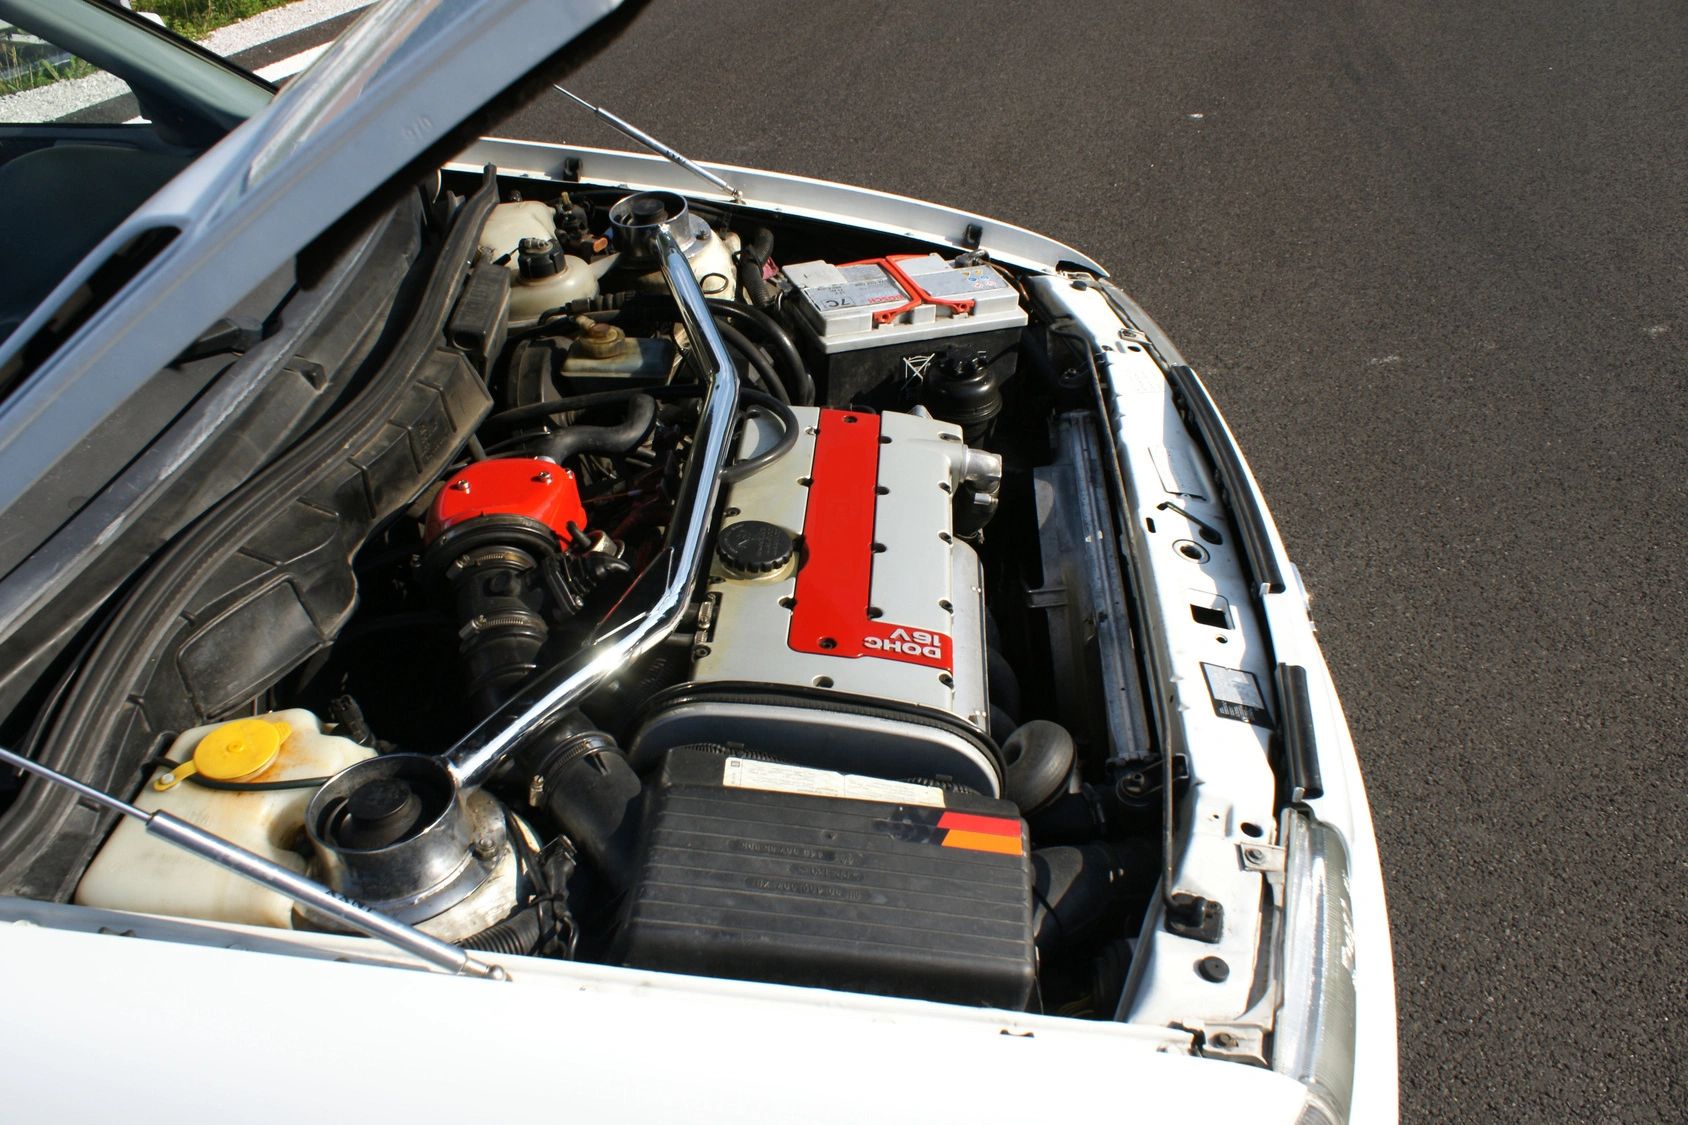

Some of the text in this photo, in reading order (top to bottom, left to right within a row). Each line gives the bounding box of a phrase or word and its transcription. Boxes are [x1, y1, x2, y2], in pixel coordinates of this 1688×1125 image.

[826, 299, 851, 308] 7C
[890, 628, 941, 646] 16V
[864, 636, 941, 659] DOHC
